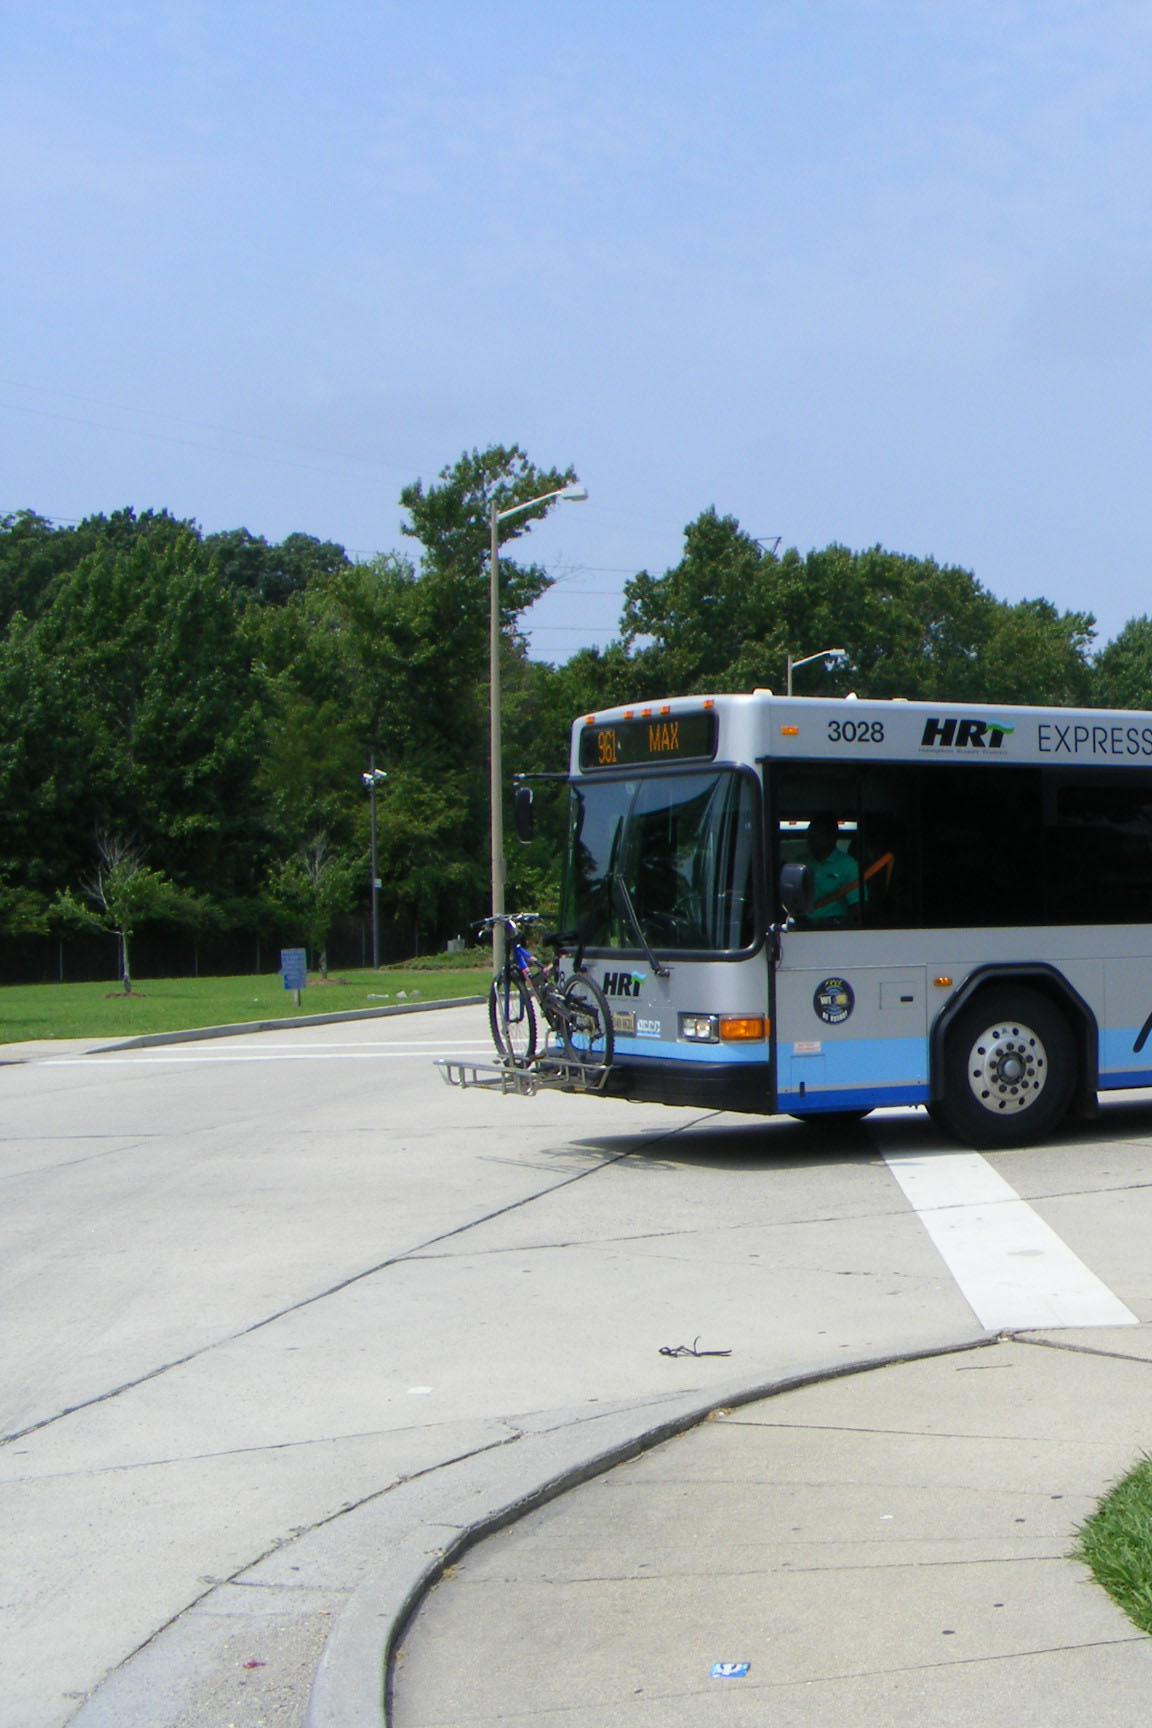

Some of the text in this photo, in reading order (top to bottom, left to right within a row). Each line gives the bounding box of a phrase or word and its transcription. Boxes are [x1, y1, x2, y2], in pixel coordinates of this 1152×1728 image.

[598, 721, 680, 765] 961 MAX
[827, 720, 885, 744] 3028
[921, 717, 1016, 749] HRT
[602, 970, 647, 996] HRT
